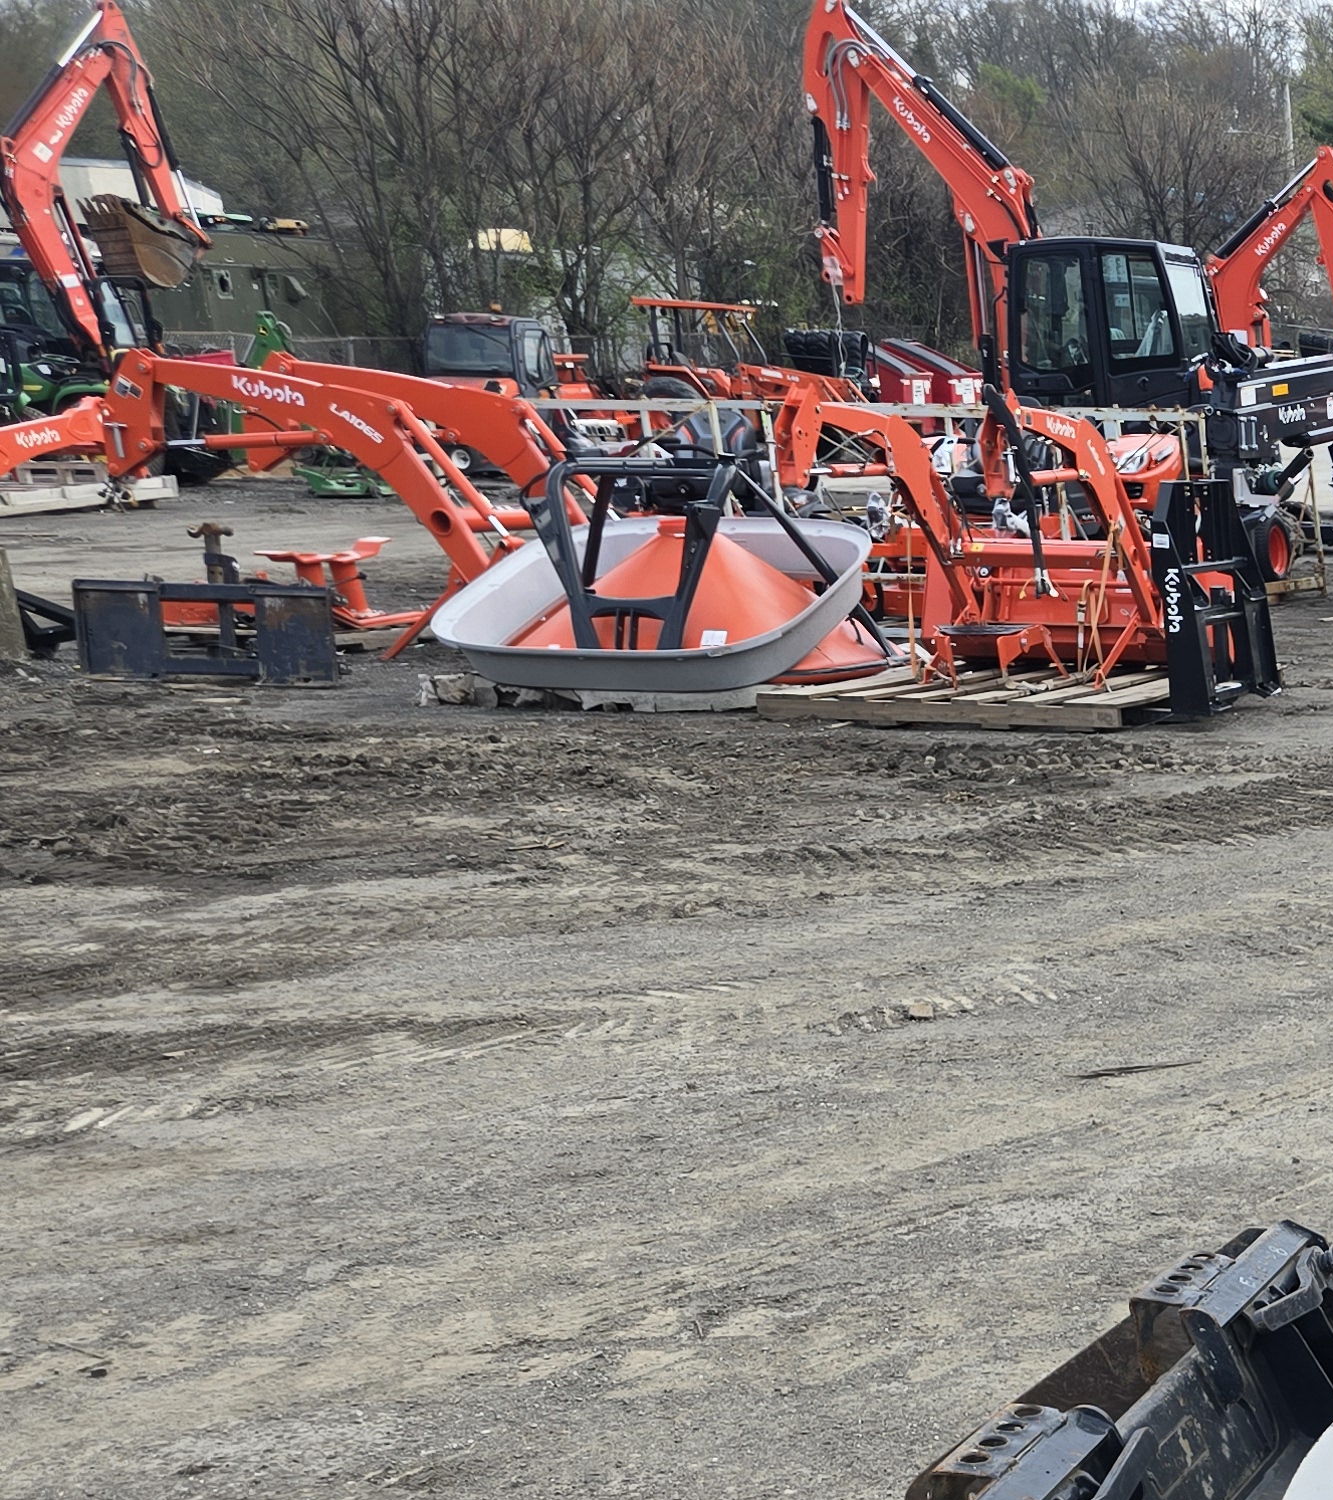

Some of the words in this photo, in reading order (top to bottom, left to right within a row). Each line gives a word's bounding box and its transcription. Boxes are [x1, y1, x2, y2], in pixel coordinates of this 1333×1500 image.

[55, 87, 89, 129] Kubota
[893, 96, 931, 143] Kubota
[1254, 222, 1287, 256] Kubota
[232, 375, 305, 407] Kubota
[329, 403, 384, 444] LA1065
[1278, 404, 1306, 424] Kubota
[15, 427, 61, 449] Kubota
[1164, 568, 1184, 633] Kubota
